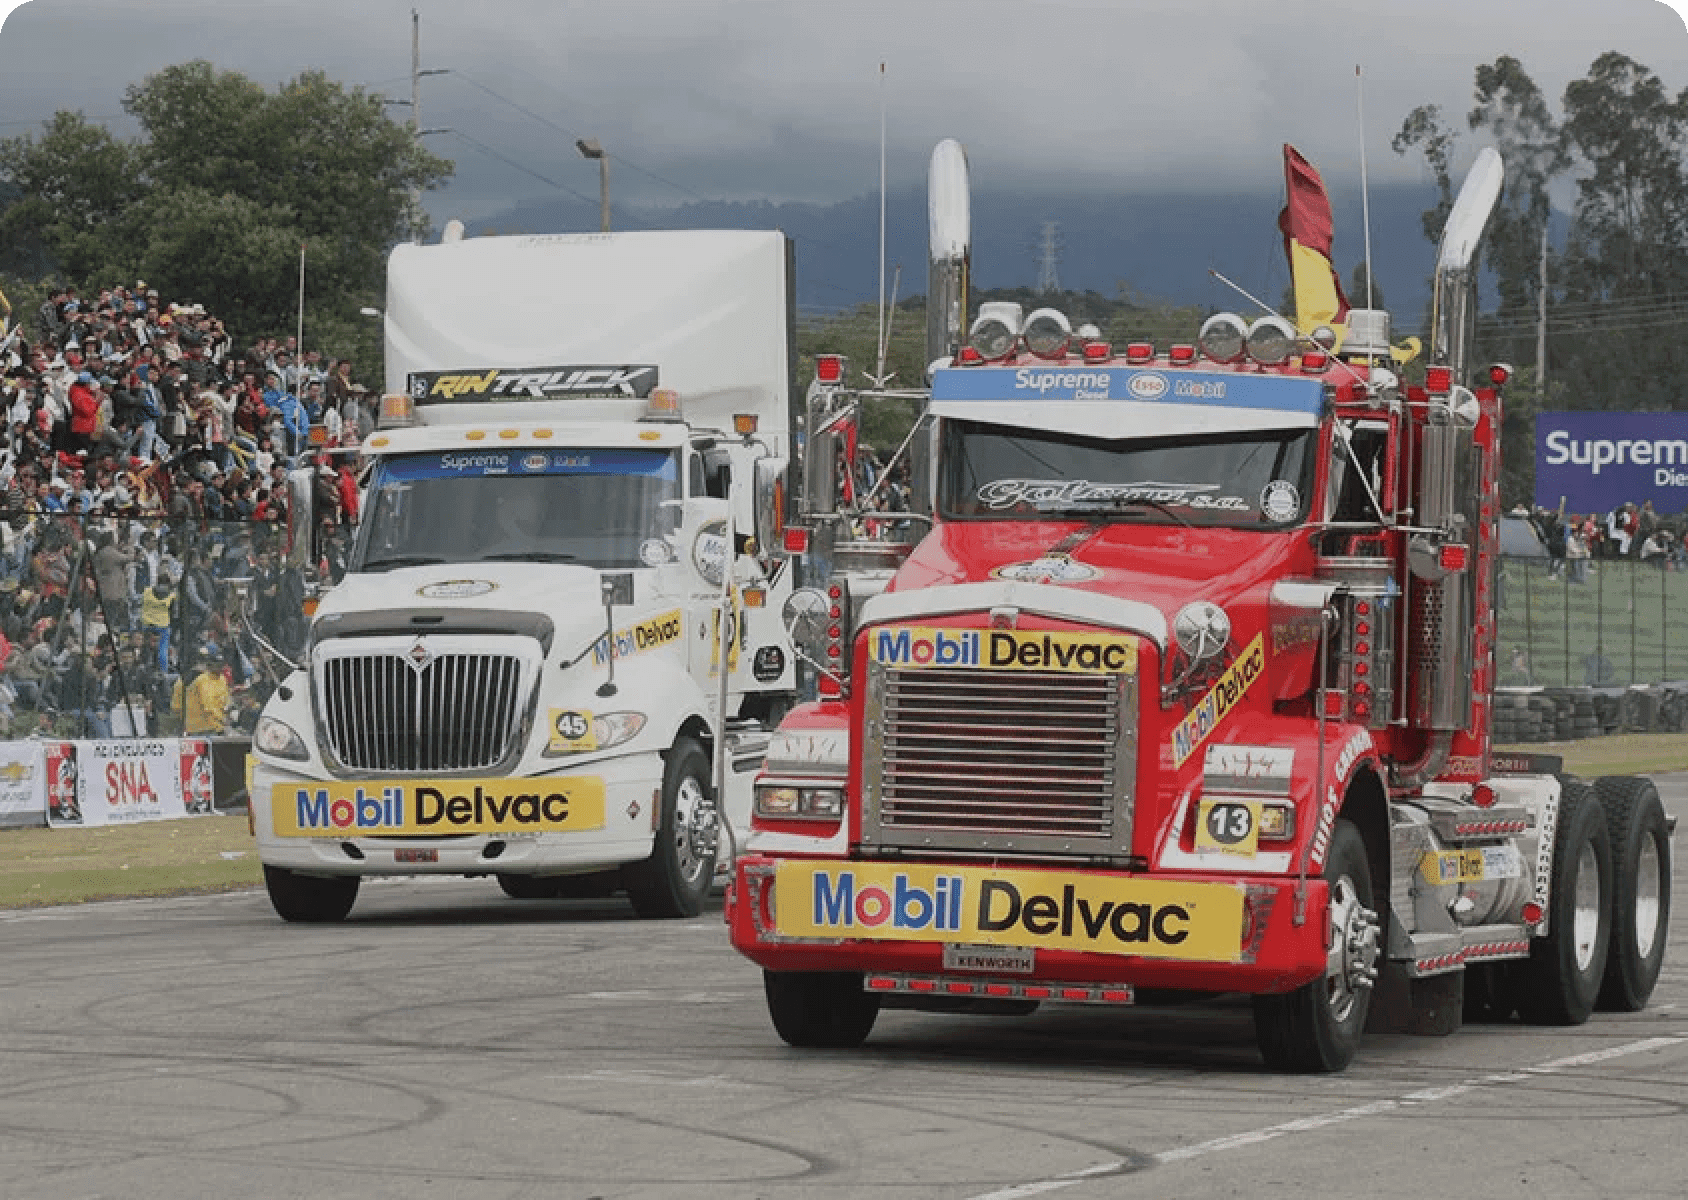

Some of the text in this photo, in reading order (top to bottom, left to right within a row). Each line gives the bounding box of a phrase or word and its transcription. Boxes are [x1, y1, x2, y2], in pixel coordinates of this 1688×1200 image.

[1015, 369, 1110, 393] Supreme
[1174, 379, 1226, 398] Mobil
[440, 454, 509, 470] Supreme
[1546, 430, 1688, 474] Suprem
[636, 618, 678, 649] Delvac
[877, 630, 1125, 669] Mobil Delvac
[1215, 646, 1262, 716] Delvac
[559, 715, 585, 735] 45
[296, 786, 570, 828] Mobil Delvac
[1212, 807, 1249, 837] 13
[813, 871, 1191, 944] Mobil Delvac
[957, 956, 1031, 970] KENWORTH
